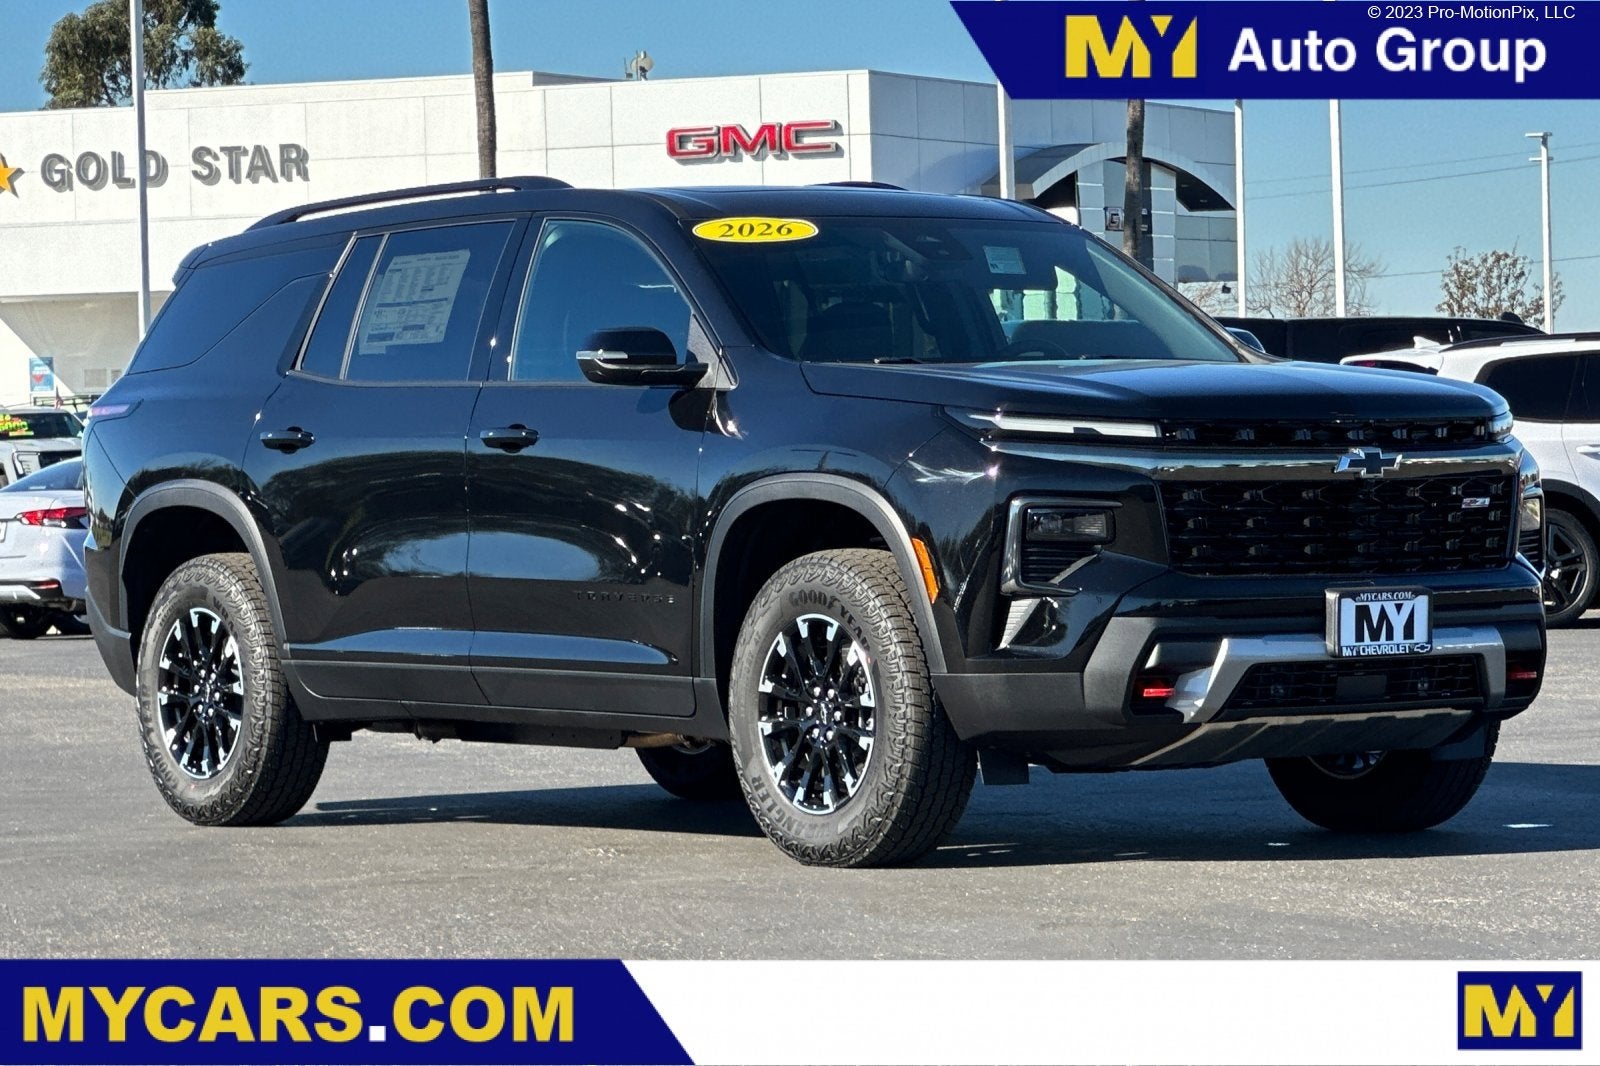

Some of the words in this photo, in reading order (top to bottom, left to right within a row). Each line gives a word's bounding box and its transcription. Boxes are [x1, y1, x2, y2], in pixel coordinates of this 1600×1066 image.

[666, 119, 838, 160] GMC
[40, 150, 168, 191] GOLD
[191, 143, 309, 185] STAR
[718, 222, 793, 239] 2026
[1359, 591, 1412, 602] MYCARS.COM
[1355, 602, 1415, 643] MY
[1360, 643, 1410, 656] CHEVROLET
